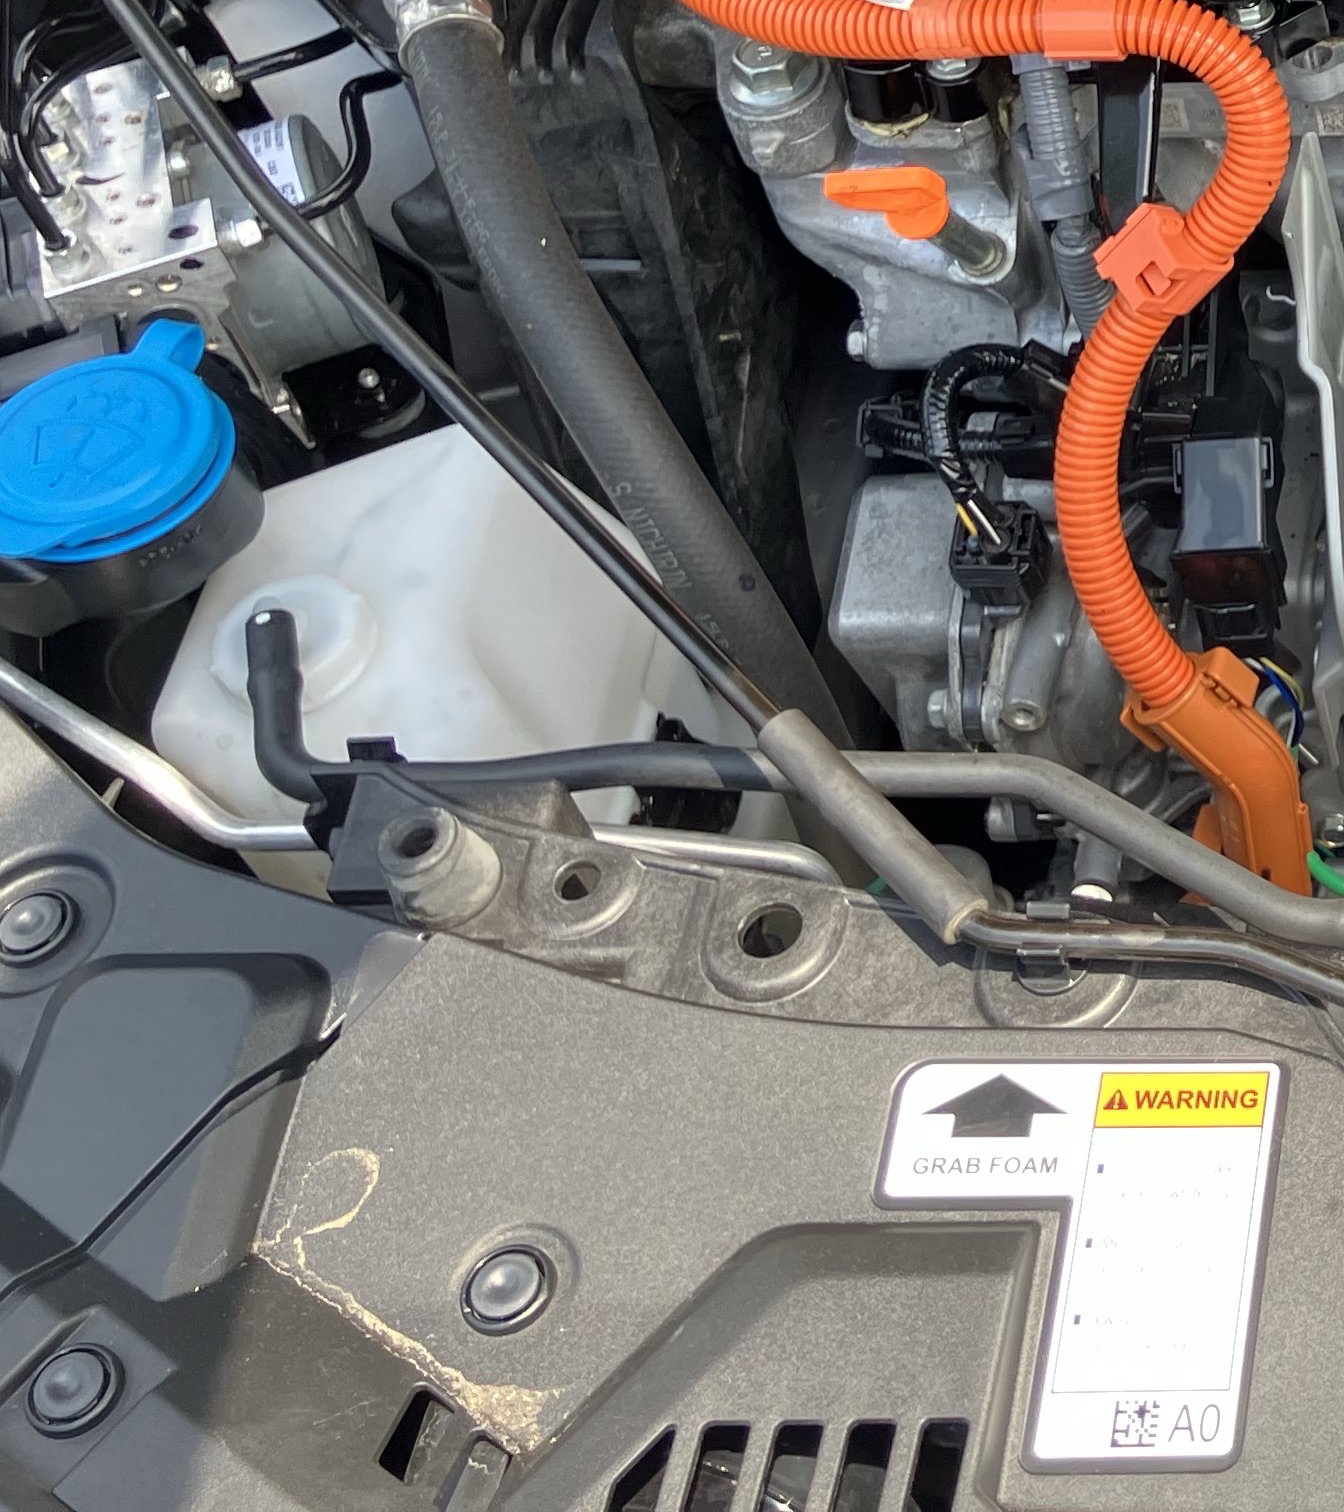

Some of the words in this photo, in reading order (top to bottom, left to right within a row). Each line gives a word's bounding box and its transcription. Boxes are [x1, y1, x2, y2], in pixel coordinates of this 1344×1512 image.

[1135, 1088, 1259, 1110] WARNING
[912, 1156, 982, 1175] GRAB
[989, 1156, 1059, 1174] FOAM
